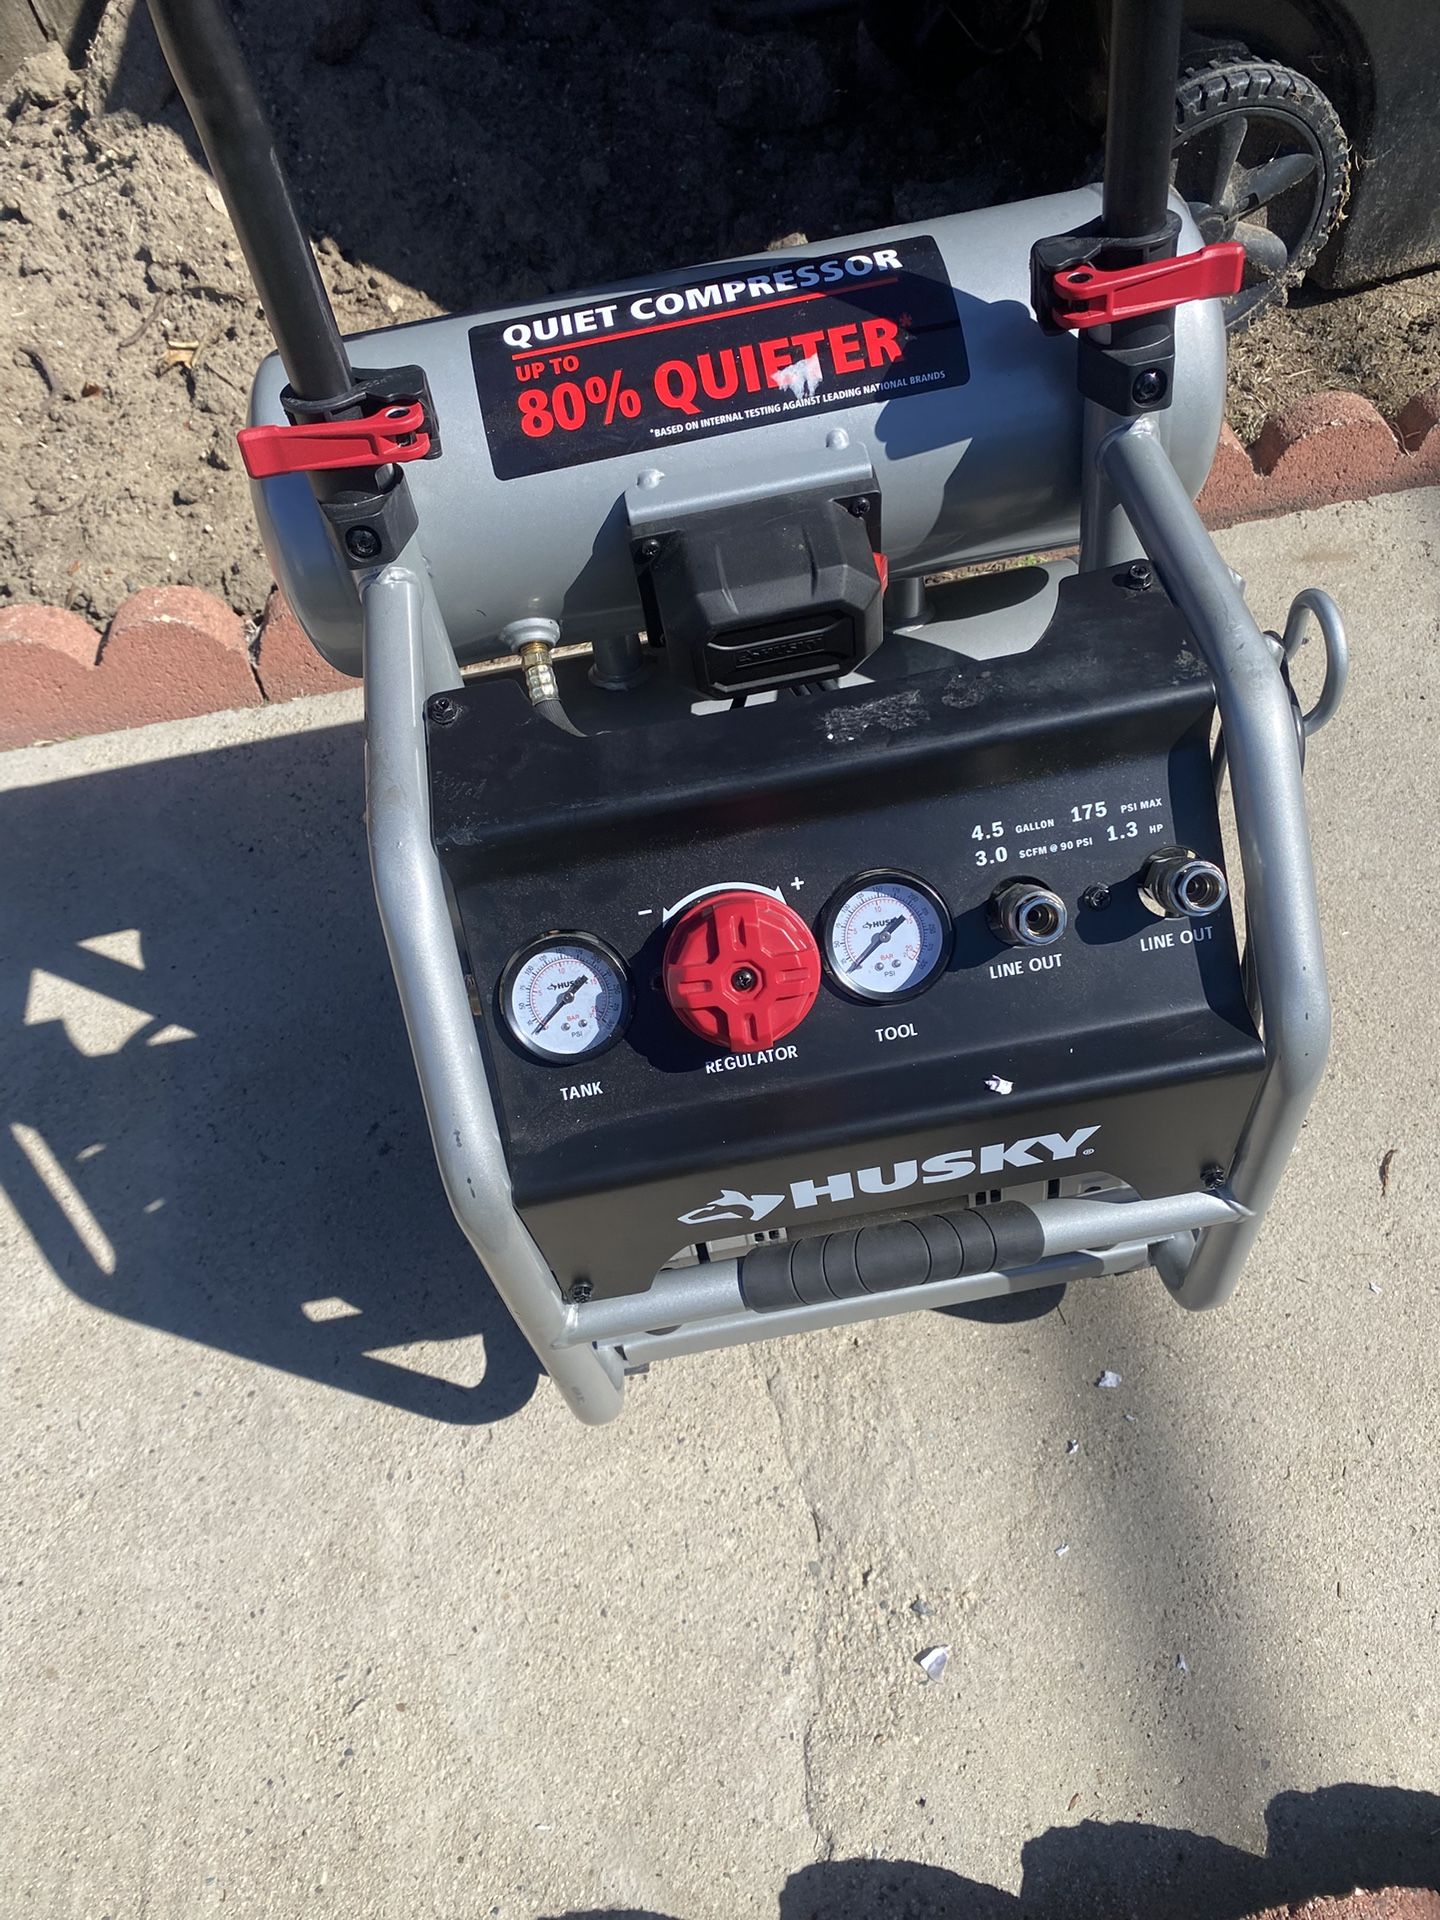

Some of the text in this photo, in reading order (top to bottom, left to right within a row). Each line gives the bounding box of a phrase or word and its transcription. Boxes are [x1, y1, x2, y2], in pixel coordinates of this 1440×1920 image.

[502, 249, 904, 349] QUIET COMPRESSOR
[514, 355, 580, 382] UP TO
[517, 369, 642, 438] 80%
[685, 420, 699, 431] ON
[700, 411, 744, 428] INTERNAL
[744, 403, 782, 419] TESTING
[782, 394, 822, 412] AGAINST
[822, 386, 862, 402] LEADING
[862, 377, 909, 395] NATIONAL
[910, 370, 946, 386] BRANDS
[971, 798, 1164, 841] 4.5 GALLON 175 PSI MAX
[974, 846, 1009, 867] 3.0
[1018, 845, 1048, 859] SCFM
[1059, 840, 1074, 852] 90
[1076, 837, 1094, 849] PSI
[1106, 821, 1139, 842] 1.3
[1148, 823, 1164, 835] HP
[1139, 926, 1215, 952] LINE OUT
[989, 953, 1064, 980] LINE OUT
[875, 1023, 918, 1043] TOOL
[705, 1045, 799, 1075] REGULATOR
[560, 1081, 603, 1101] TANK
